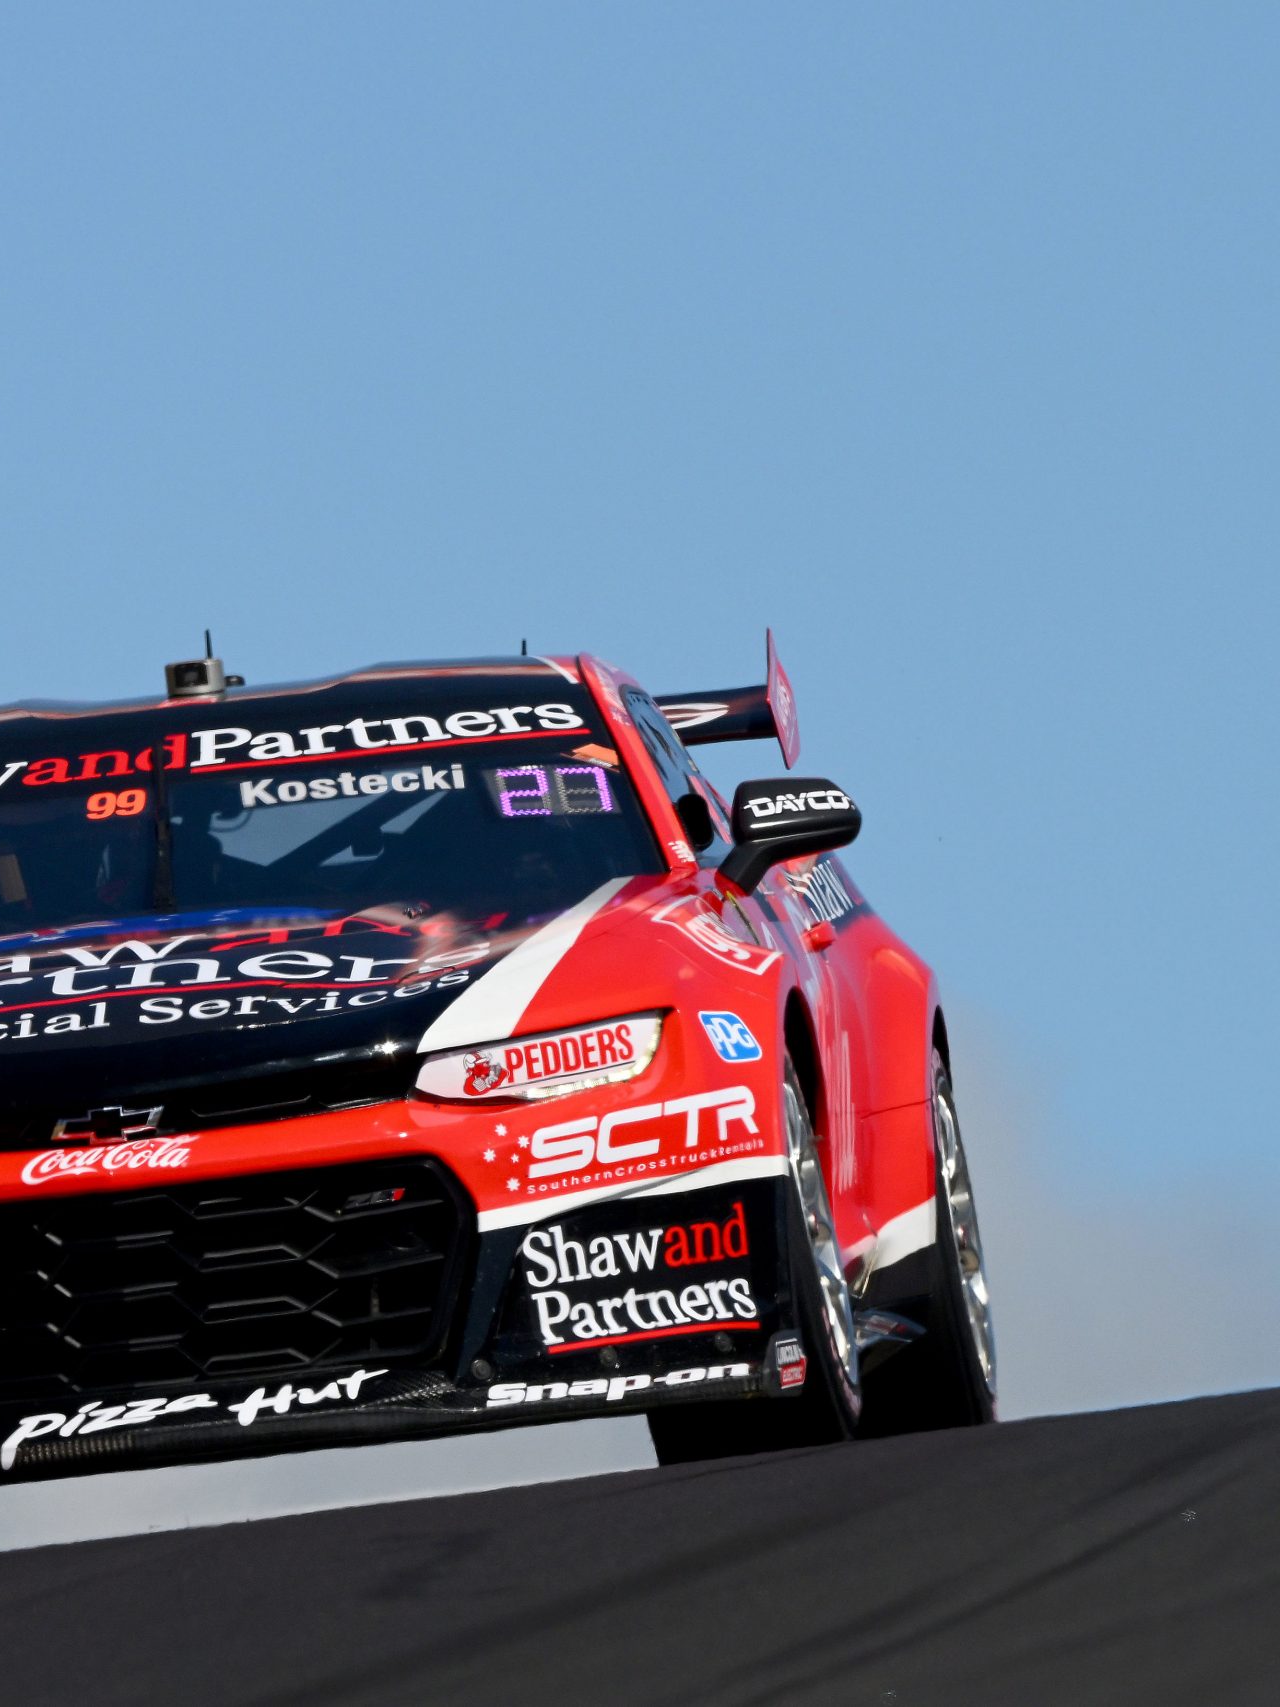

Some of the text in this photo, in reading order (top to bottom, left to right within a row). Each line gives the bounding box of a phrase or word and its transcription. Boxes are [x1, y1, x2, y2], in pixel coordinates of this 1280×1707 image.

[85, 788, 147, 821] 99
[239, 764, 465, 809] Kostecki
[495, 766, 613, 816] 27
[743, 789, 853, 818] DAYCO
[138, 969, 471, 1024] Services
[506, 1023, 635, 1084] PEDDERS
[706, 1016, 756, 1058] PPG
[527, 1085, 760, 1179] SCTR
[530, 1277, 758, 1346] Partners
[0, 1367, 389, 1471] Pizza Hut
